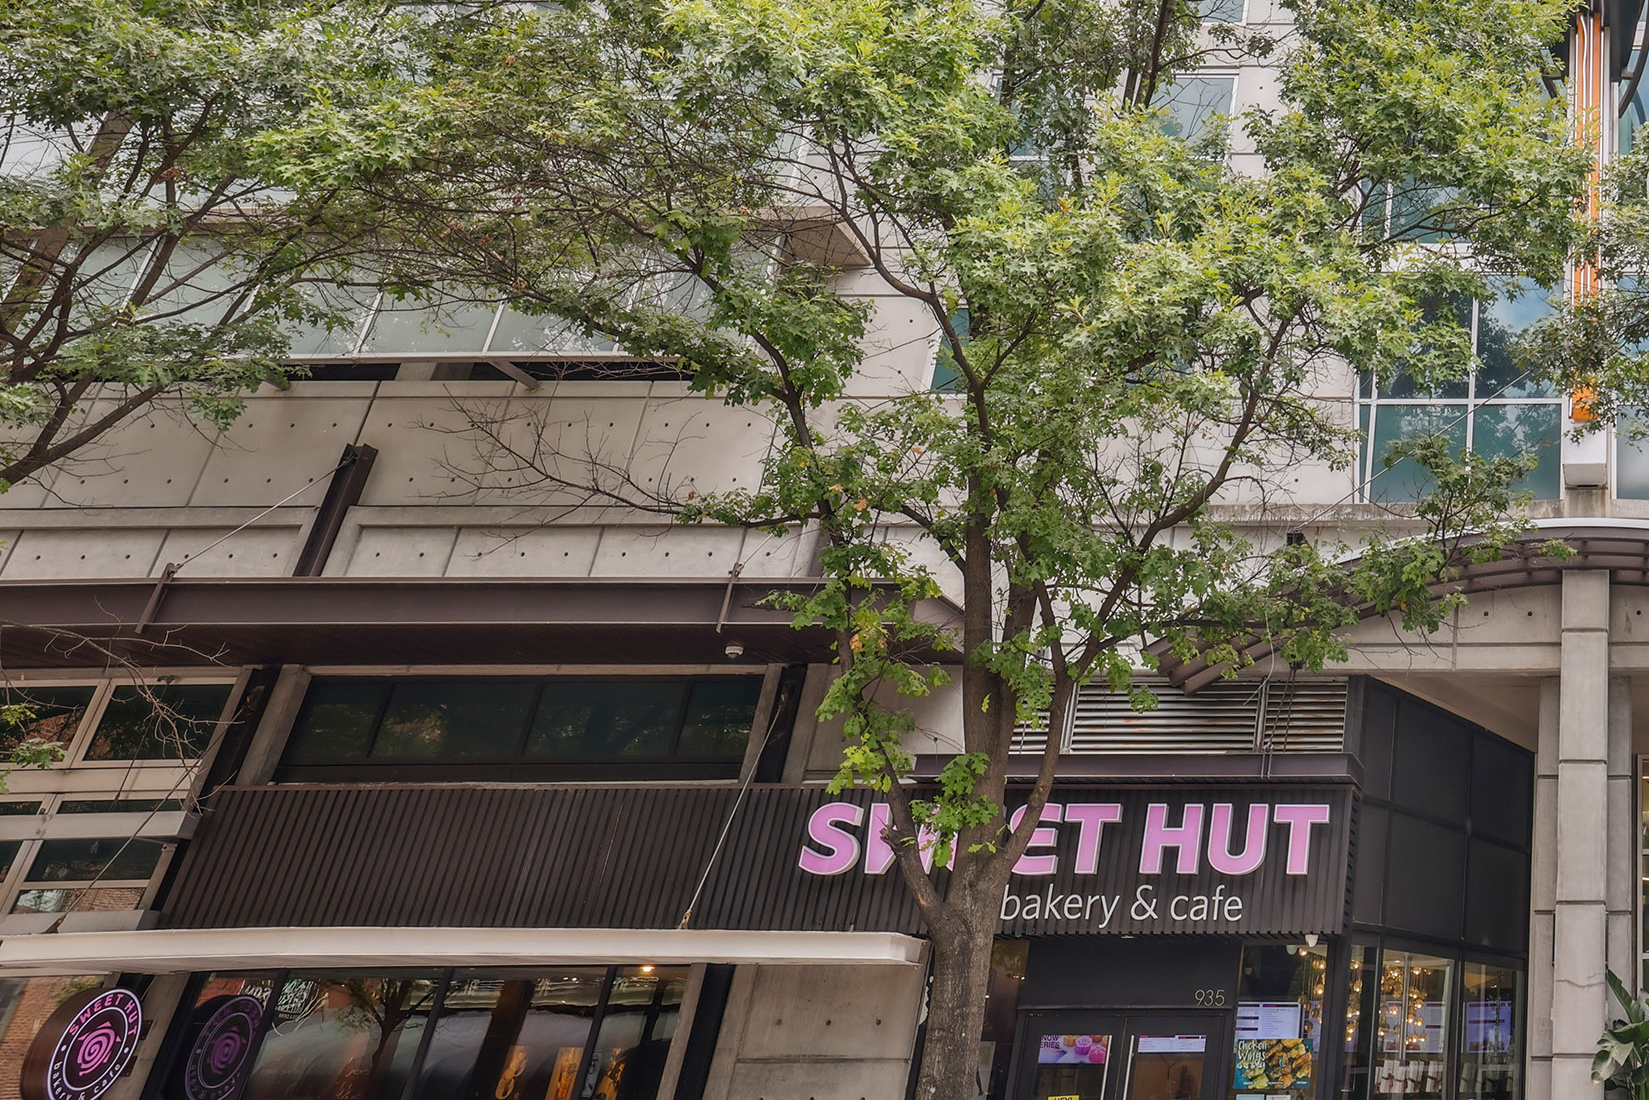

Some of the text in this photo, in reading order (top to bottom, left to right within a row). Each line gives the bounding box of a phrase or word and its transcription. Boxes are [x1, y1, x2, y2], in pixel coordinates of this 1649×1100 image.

[1139, 803, 1330, 875] HUT
[1000, 884, 1243, 929] bakery & cafe
[69, 994, 138, 1035] SWEET HUT
[1194, 989, 1225, 1006] 935
[94, 1064, 120, 1094] cafe
